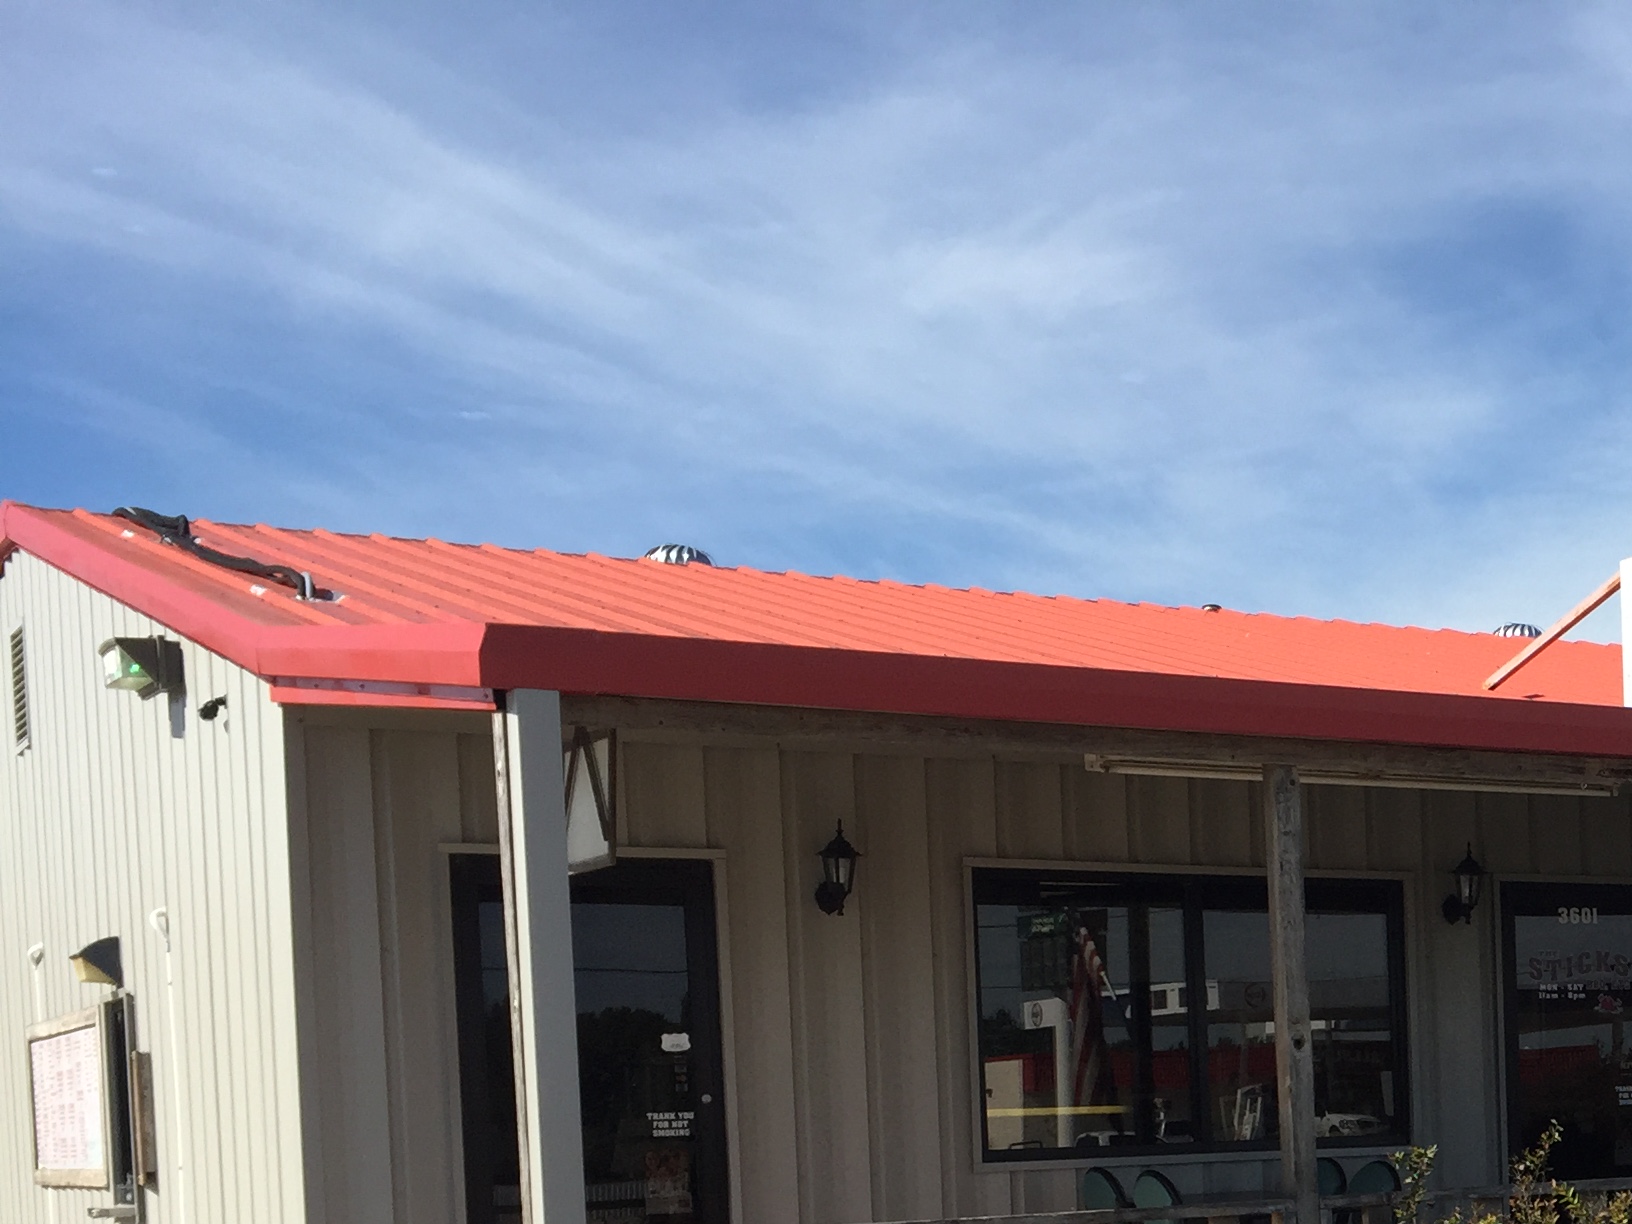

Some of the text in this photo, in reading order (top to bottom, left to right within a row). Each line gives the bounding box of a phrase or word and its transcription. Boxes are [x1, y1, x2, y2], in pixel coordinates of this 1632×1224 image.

[1557, 907, 1598, 924] 3601
[1528, 950, 1630, 981] STICKS
[646, 1112, 676, 1120] THANK
[652, 1128, 691, 1137] SMOKING
